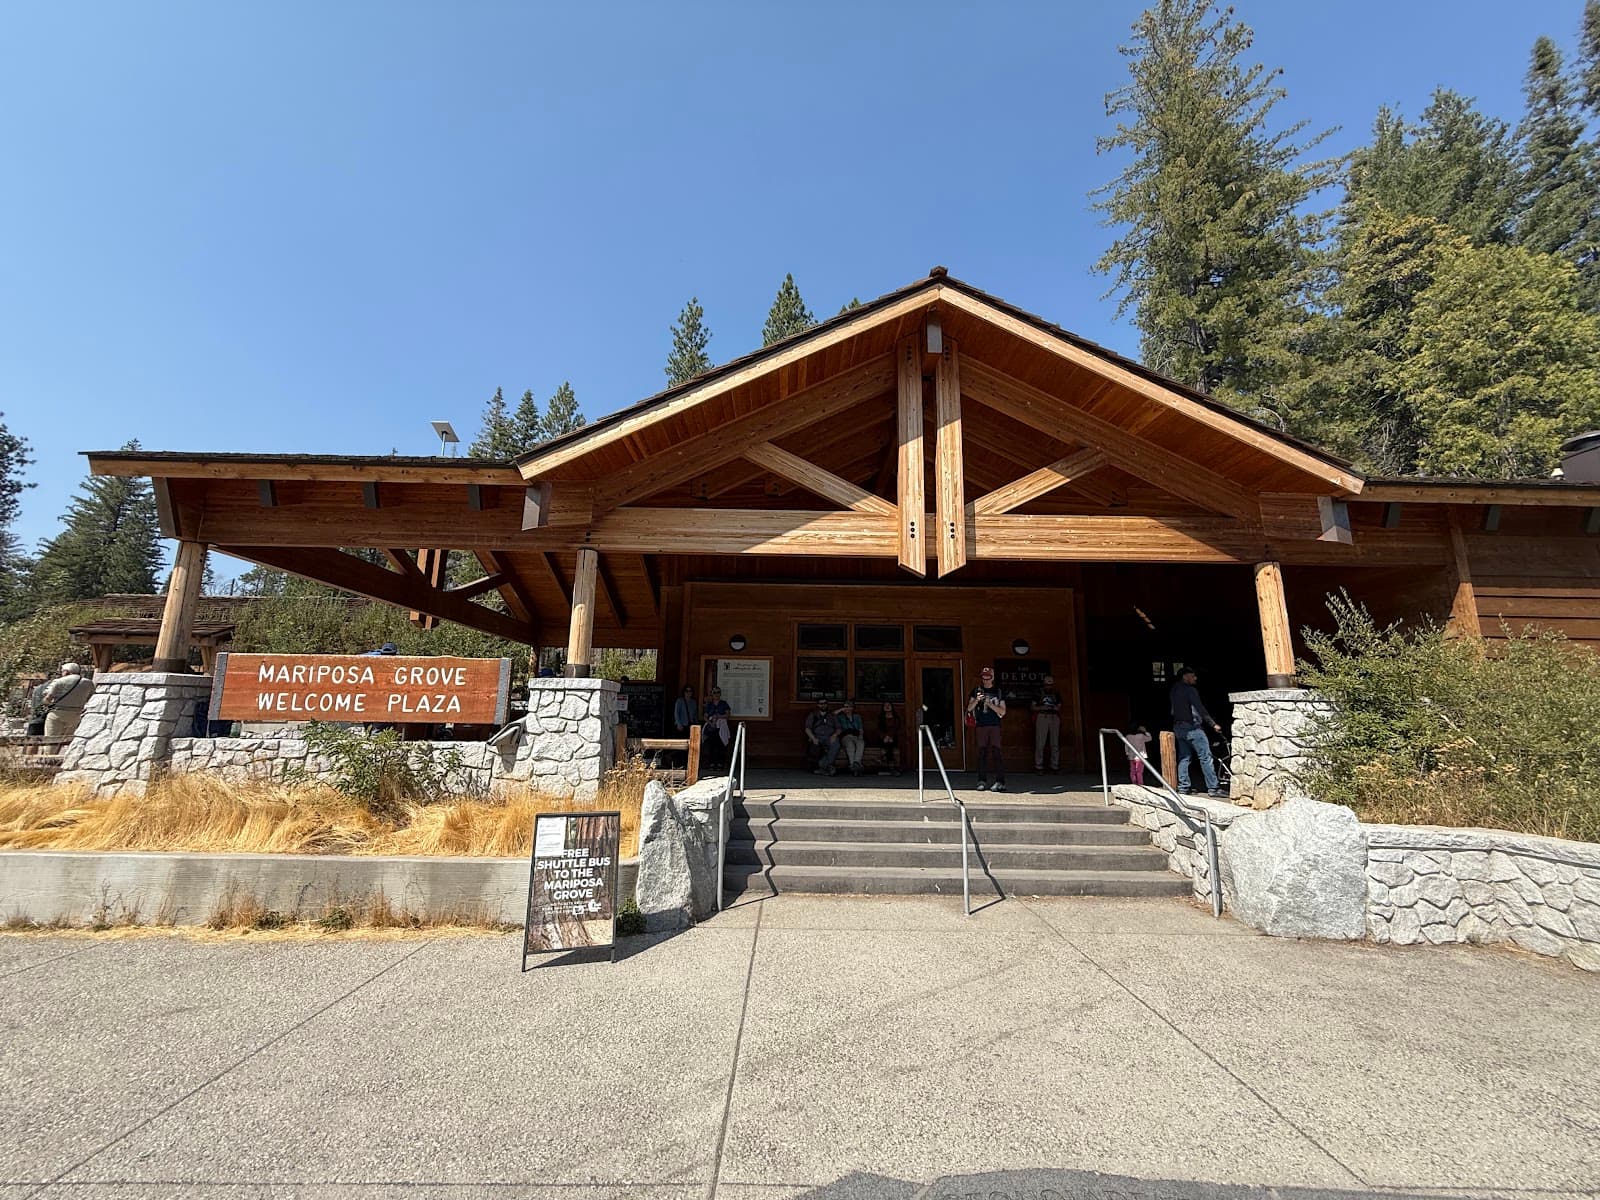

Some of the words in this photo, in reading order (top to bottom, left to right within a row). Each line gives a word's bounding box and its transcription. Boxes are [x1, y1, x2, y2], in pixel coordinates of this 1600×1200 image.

[258, 664, 374, 685] MARIPOSA
[394, 666, 467, 686] GROVE
[1001, 672, 1046, 681] DEPOT
[257, 692, 367, 712] WELCOME
[387, 694, 461, 713] PLAZA
[561, 848, 590, 858] FREE
[537, 859, 587, 870] SHUTTLE
[588, 857, 611, 867] BUS
[554, 870, 569, 879] TO
[571, 868, 593, 878] THE
[544, 878, 604, 890] MARIPOSA
[553, 889, 593, 900] GROVE
